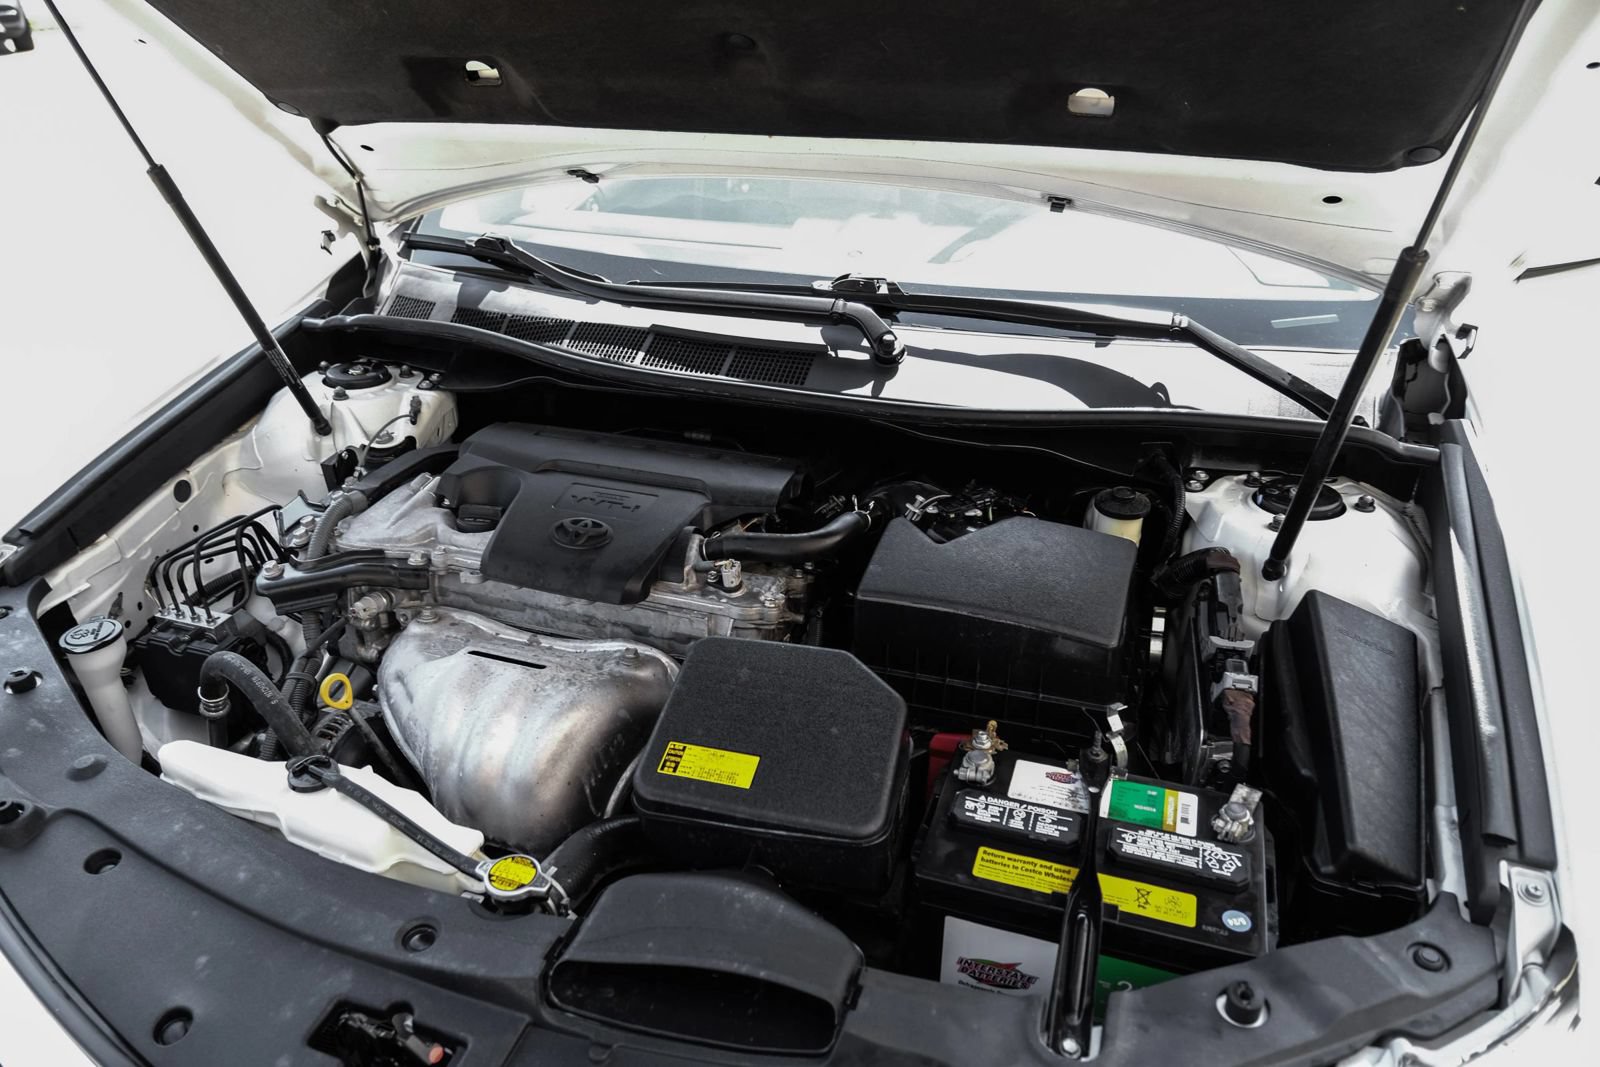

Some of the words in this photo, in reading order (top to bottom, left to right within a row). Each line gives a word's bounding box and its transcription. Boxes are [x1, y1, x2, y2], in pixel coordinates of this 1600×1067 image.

[987, 796, 1020, 809] DANGER
[1027, 805, 1058, 817] POISON
[980, 857, 1011, 868] batteries
[1020, 866, 1043, 876] Costco
[982, 850, 1007, 860] Return
[1007, 856, 1038, 868] warranty
[1039, 863, 1053, 871] and
[1054, 866, 1072, 875] used
[956, 957, 1040, 984] INTERSTATE
[957, 965, 1031, 990] BATTERIES
